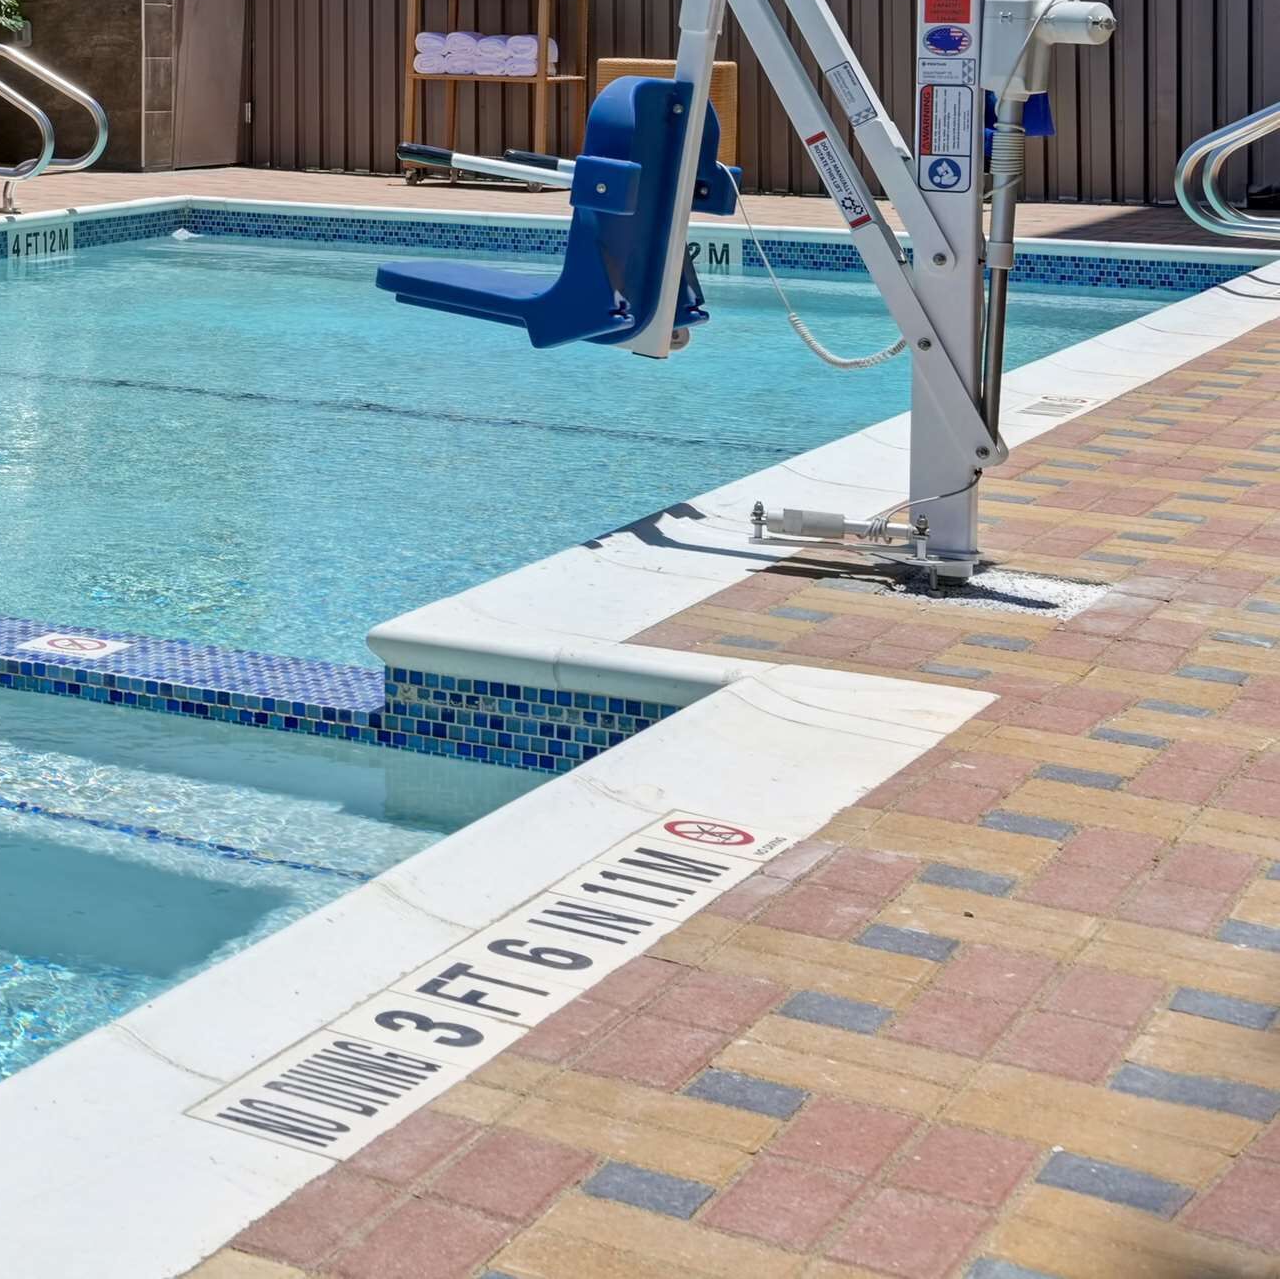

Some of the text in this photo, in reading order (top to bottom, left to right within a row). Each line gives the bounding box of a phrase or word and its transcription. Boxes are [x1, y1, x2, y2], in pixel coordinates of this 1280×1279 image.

[922, 91, 931, 141] WARNING
[814, 144, 843, 193] ROTATE THIS LIFT
[821, 141, 853, 196] DO NOT MANUALLY
[12, 234, 21, 257] 4
[26, 231, 40, 256] FT
[59, 227, 69, 251] M
[709, 242, 730, 265] M
[216, 846, 731, 1148] NO DIVING 3 FT 6 IN 1.1 M
